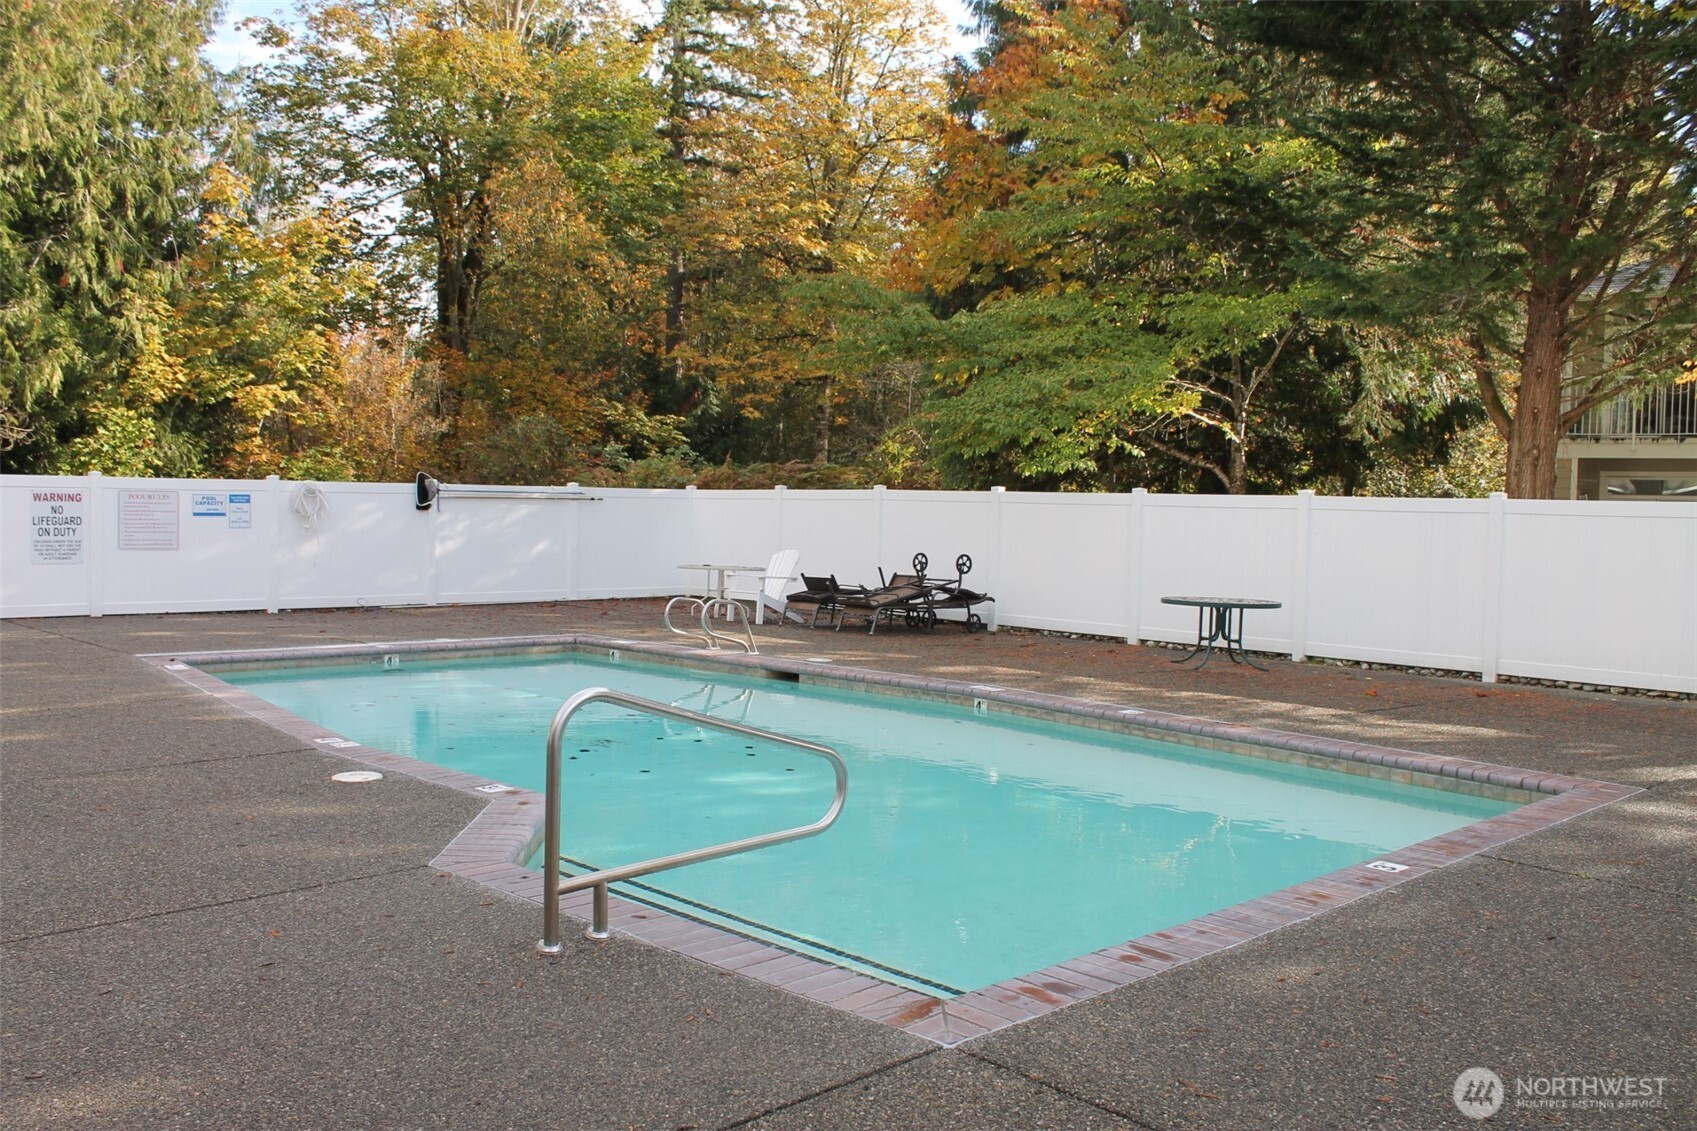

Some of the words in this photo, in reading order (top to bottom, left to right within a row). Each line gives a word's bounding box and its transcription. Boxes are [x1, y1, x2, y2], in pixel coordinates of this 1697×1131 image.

[33, 493, 82, 502] WARNING
[51, 505, 64, 515] NO
[32, 516, 82, 526] LIFEGUARD
[37, 527, 51, 537] ON
[53, 527, 77, 537] DUTY
